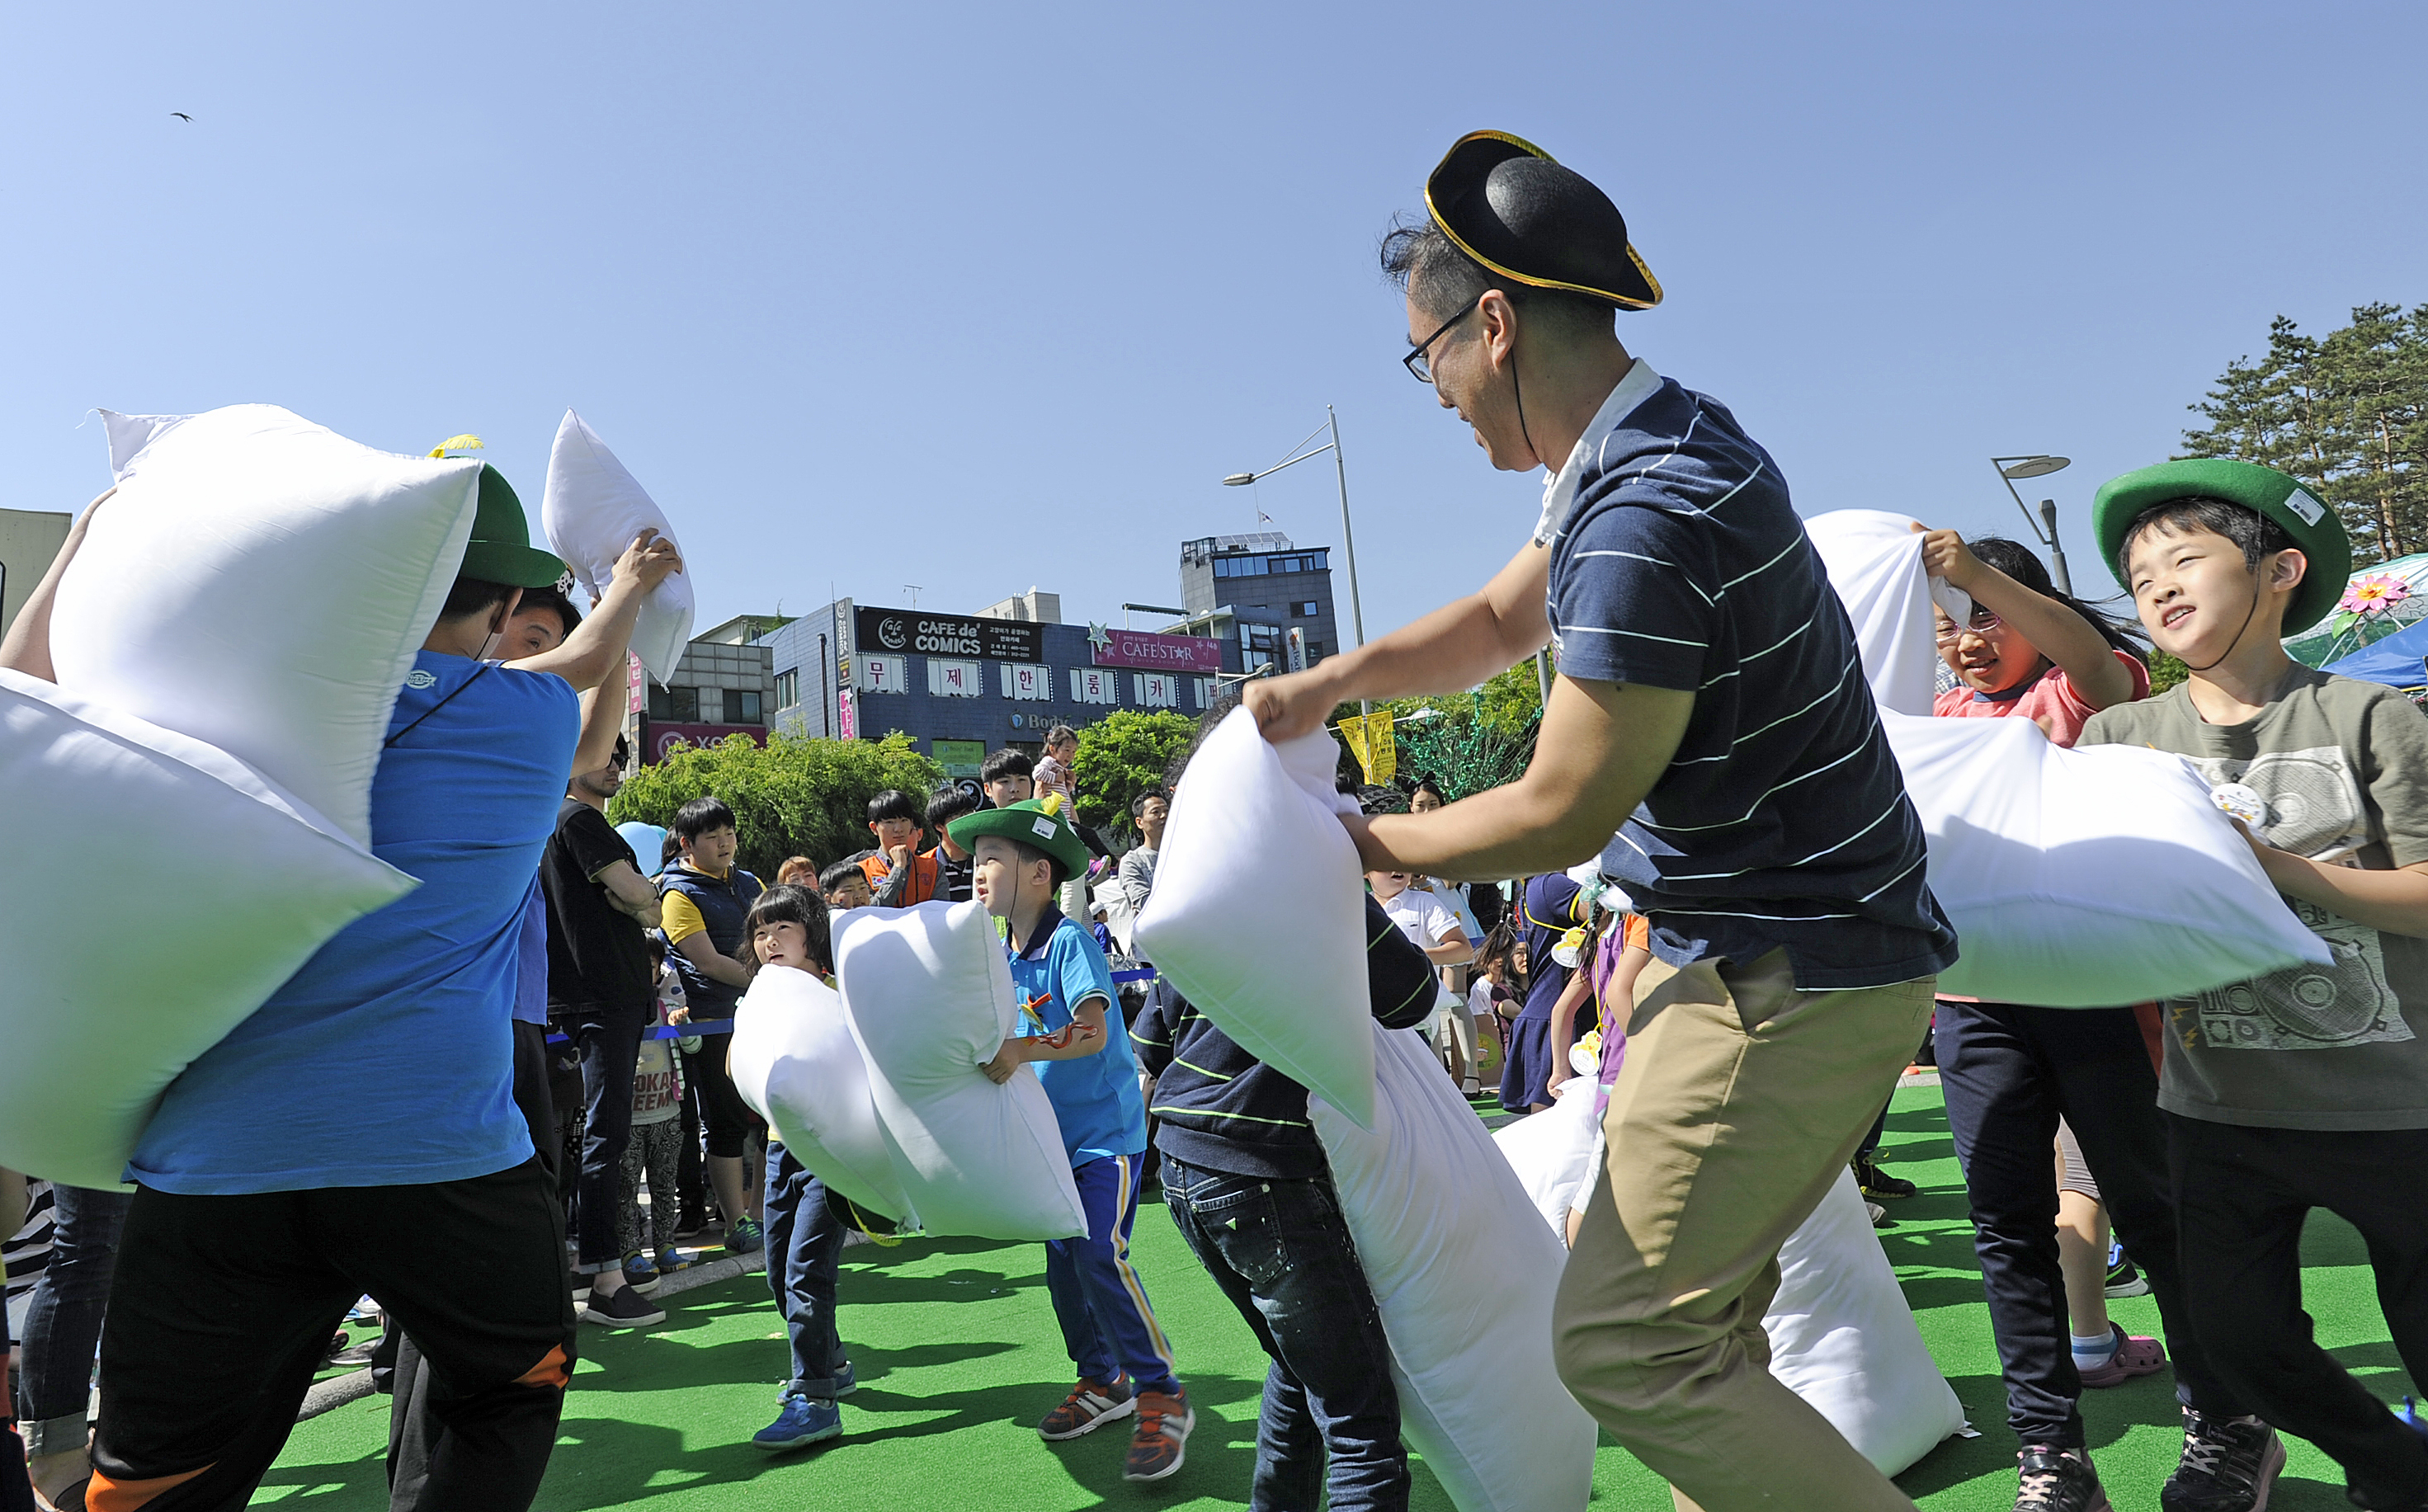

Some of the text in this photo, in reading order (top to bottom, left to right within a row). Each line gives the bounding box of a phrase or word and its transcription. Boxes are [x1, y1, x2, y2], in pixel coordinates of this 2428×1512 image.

[917, 620, 957, 635] CAFE
[915, 634, 982, 655] COMICS
[1122, 641, 1157, 658] CAFE
[1293, 651, 1301, 672] Bod
[869, 662, 884, 685] 무
[945, 668, 962, 689] 제
[1018, 670, 1033, 691] 한
[1149, 679, 1163, 698] 카
[634, 1071, 672, 1093] OKA
[632, 1090, 670, 1111] EEM
